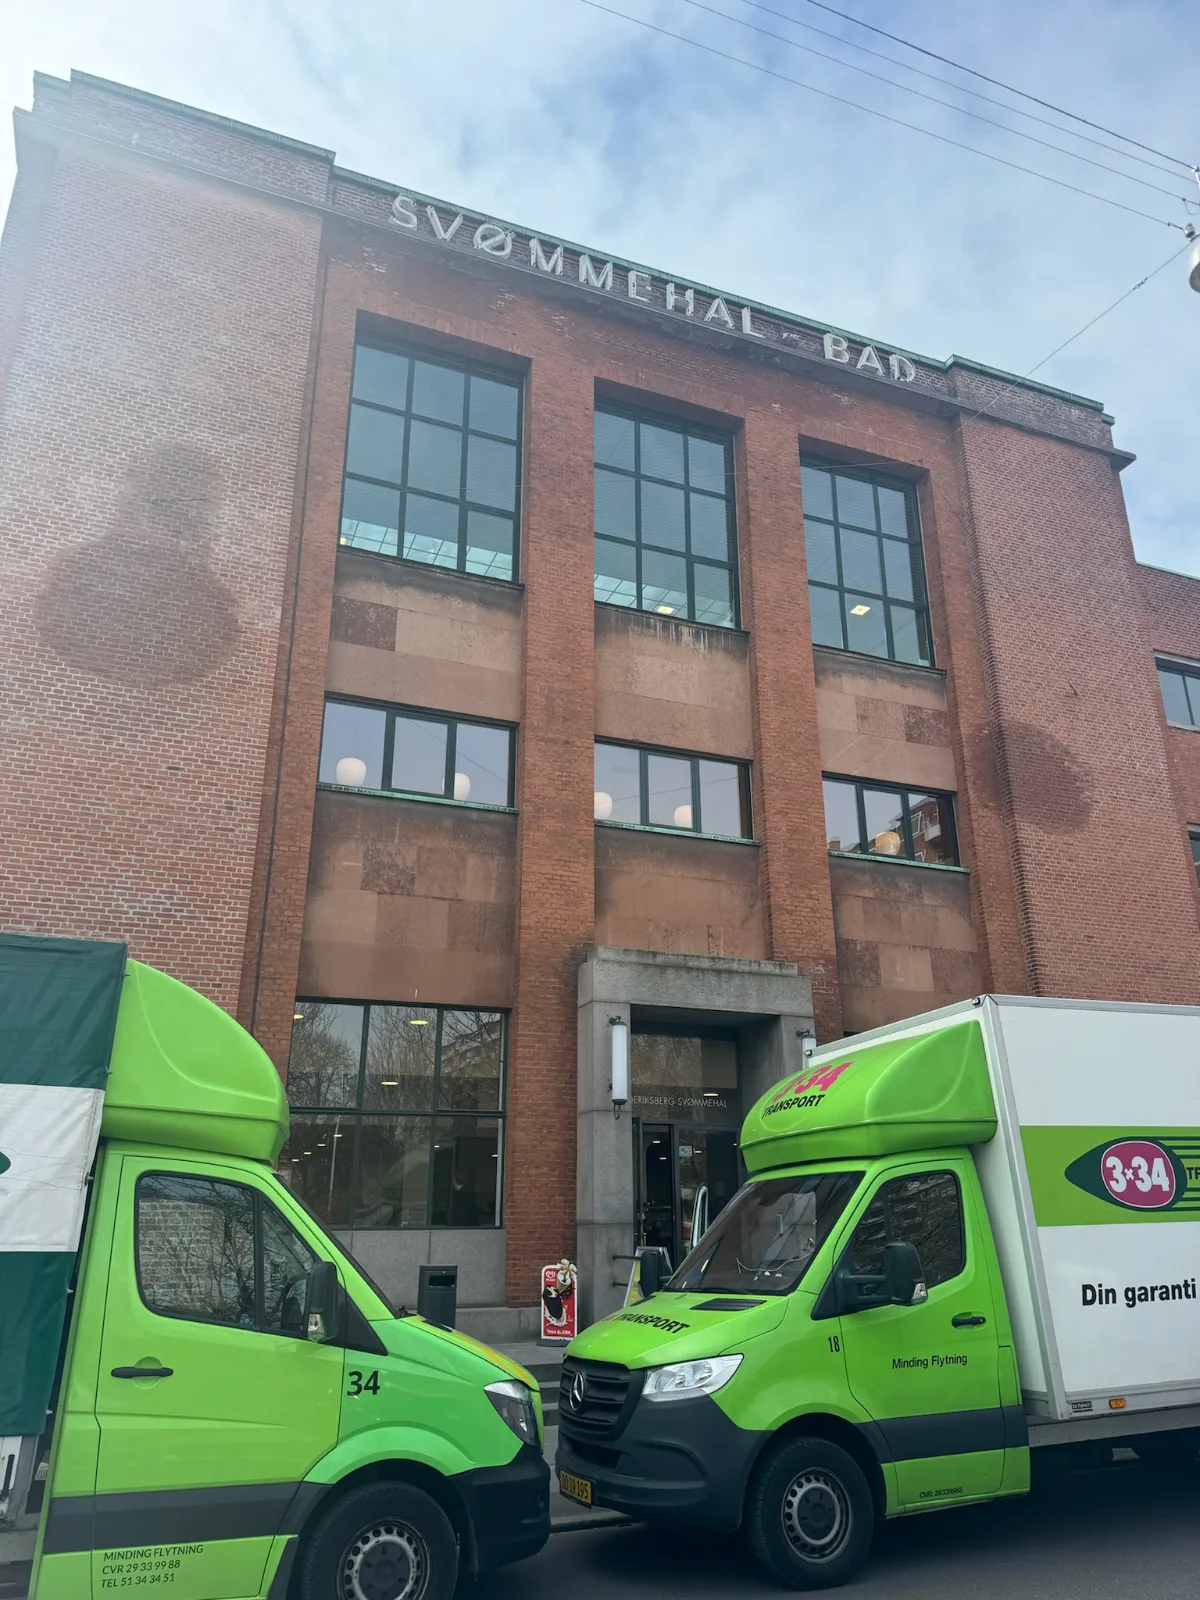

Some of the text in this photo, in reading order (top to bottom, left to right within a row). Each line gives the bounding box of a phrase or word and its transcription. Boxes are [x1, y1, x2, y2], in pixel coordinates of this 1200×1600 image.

[388, 193, 916, 383] SVØMMEHAL BAD
[677, 1097, 728, 1108] SVØMMEHAL
[761, 1094, 826, 1119] TRANSPORT
[1081, 1277, 1197, 1309] Din garanti
[614, 1313, 690, 1334] TRANSPORT
[827, 1335, 841, 1353] 18
[891, 1353, 968, 1370] Minding Flytning
[346, 1370, 381, 1397] 34
[103, 1544, 204, 1562] MINDING FLYTNING
[102, 1559, 181, 1575] CVR 29 33 99 88
[101, 1572, 175, 1588] TEL 51 34 34 51
